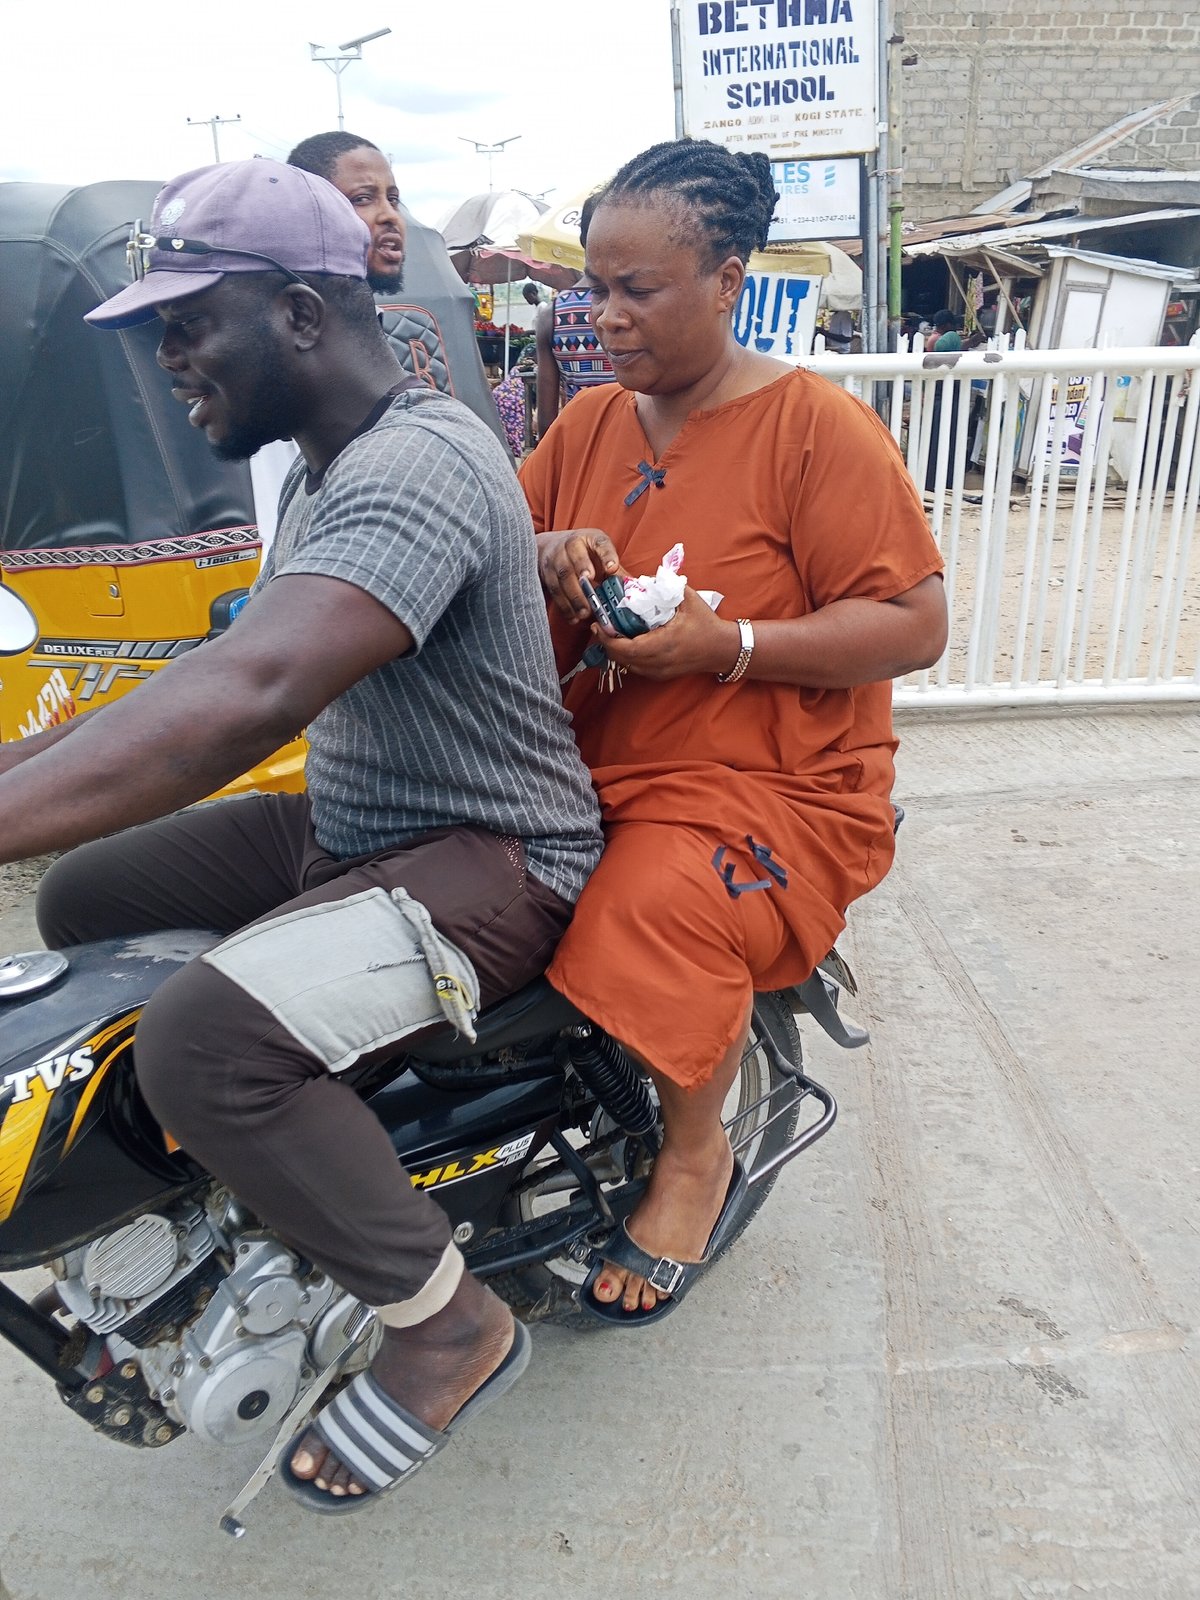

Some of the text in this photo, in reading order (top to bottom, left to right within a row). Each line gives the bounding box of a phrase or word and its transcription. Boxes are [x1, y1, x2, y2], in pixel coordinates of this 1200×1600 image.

[697, 0, 854, 36] BETHMA
[702, 36, 860, 77] INTERNATIONAL
[726, 75, 835, 110] SCHOOL
[704, 119, 742, 129] ZANGO
[795, 111, 821, 121] KOGI
[43, 644, 95, 656] DELUXE
[4, 1046, 95, 1104] TVS
[410, 1146, 501, 1188] HLX
[501, 1137, 530, 1155] PLUS
